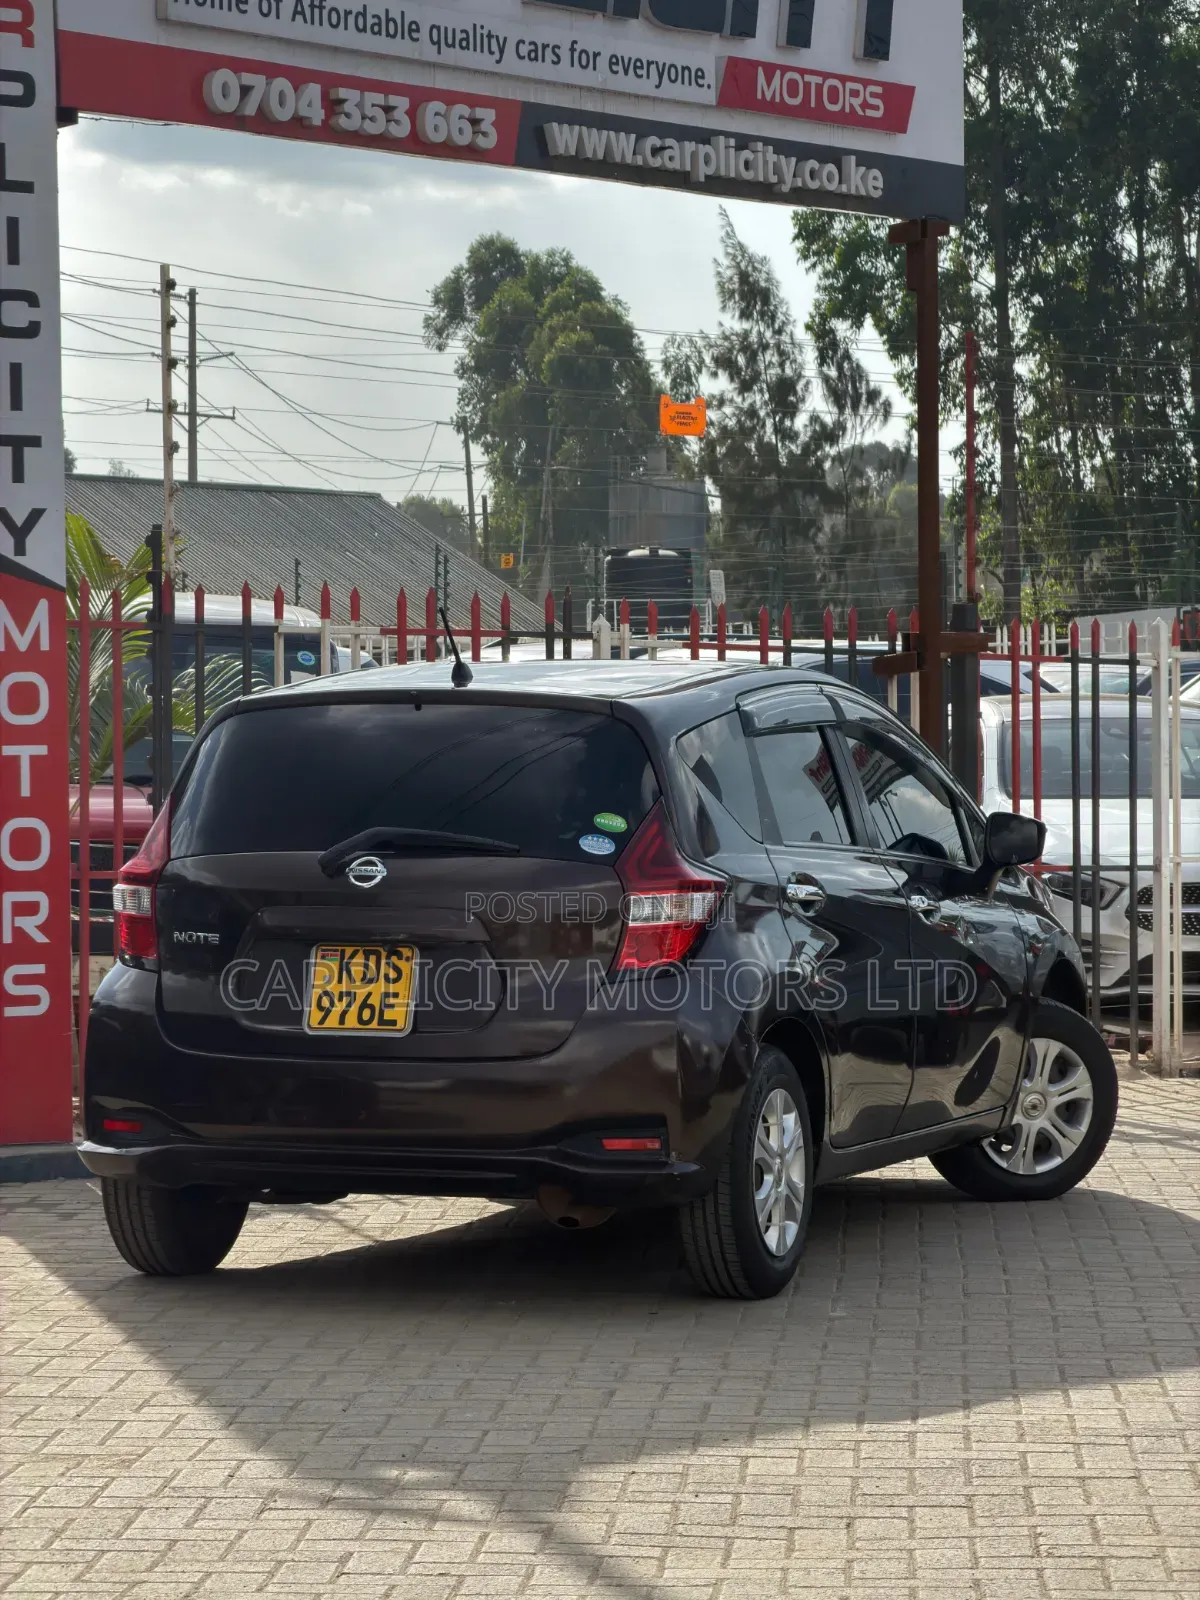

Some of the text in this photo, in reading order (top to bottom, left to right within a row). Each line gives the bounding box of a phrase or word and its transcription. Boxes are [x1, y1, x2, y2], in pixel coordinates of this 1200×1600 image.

[257, 0, 281, 20] of
[291, 0, 420, 43] Affordable
[428, 23, 508, 64] quality
[514, 38, 562, 65] cars
[568, 40, 602, 72] for
[607, 52, 712, 90] everyone.
[203, 68, 498, 150] 0704 353 663
[756, 65, 885, 118] MOTORS
[543, 121, 884, 199] www.carplicity.co.ke
[0, 598, 51, 1017] MOTORS
[173, 931, 220, 946] NOTE
[337, 948, 404, 985] KDS
[316, 989, 400, 1027] 976E
